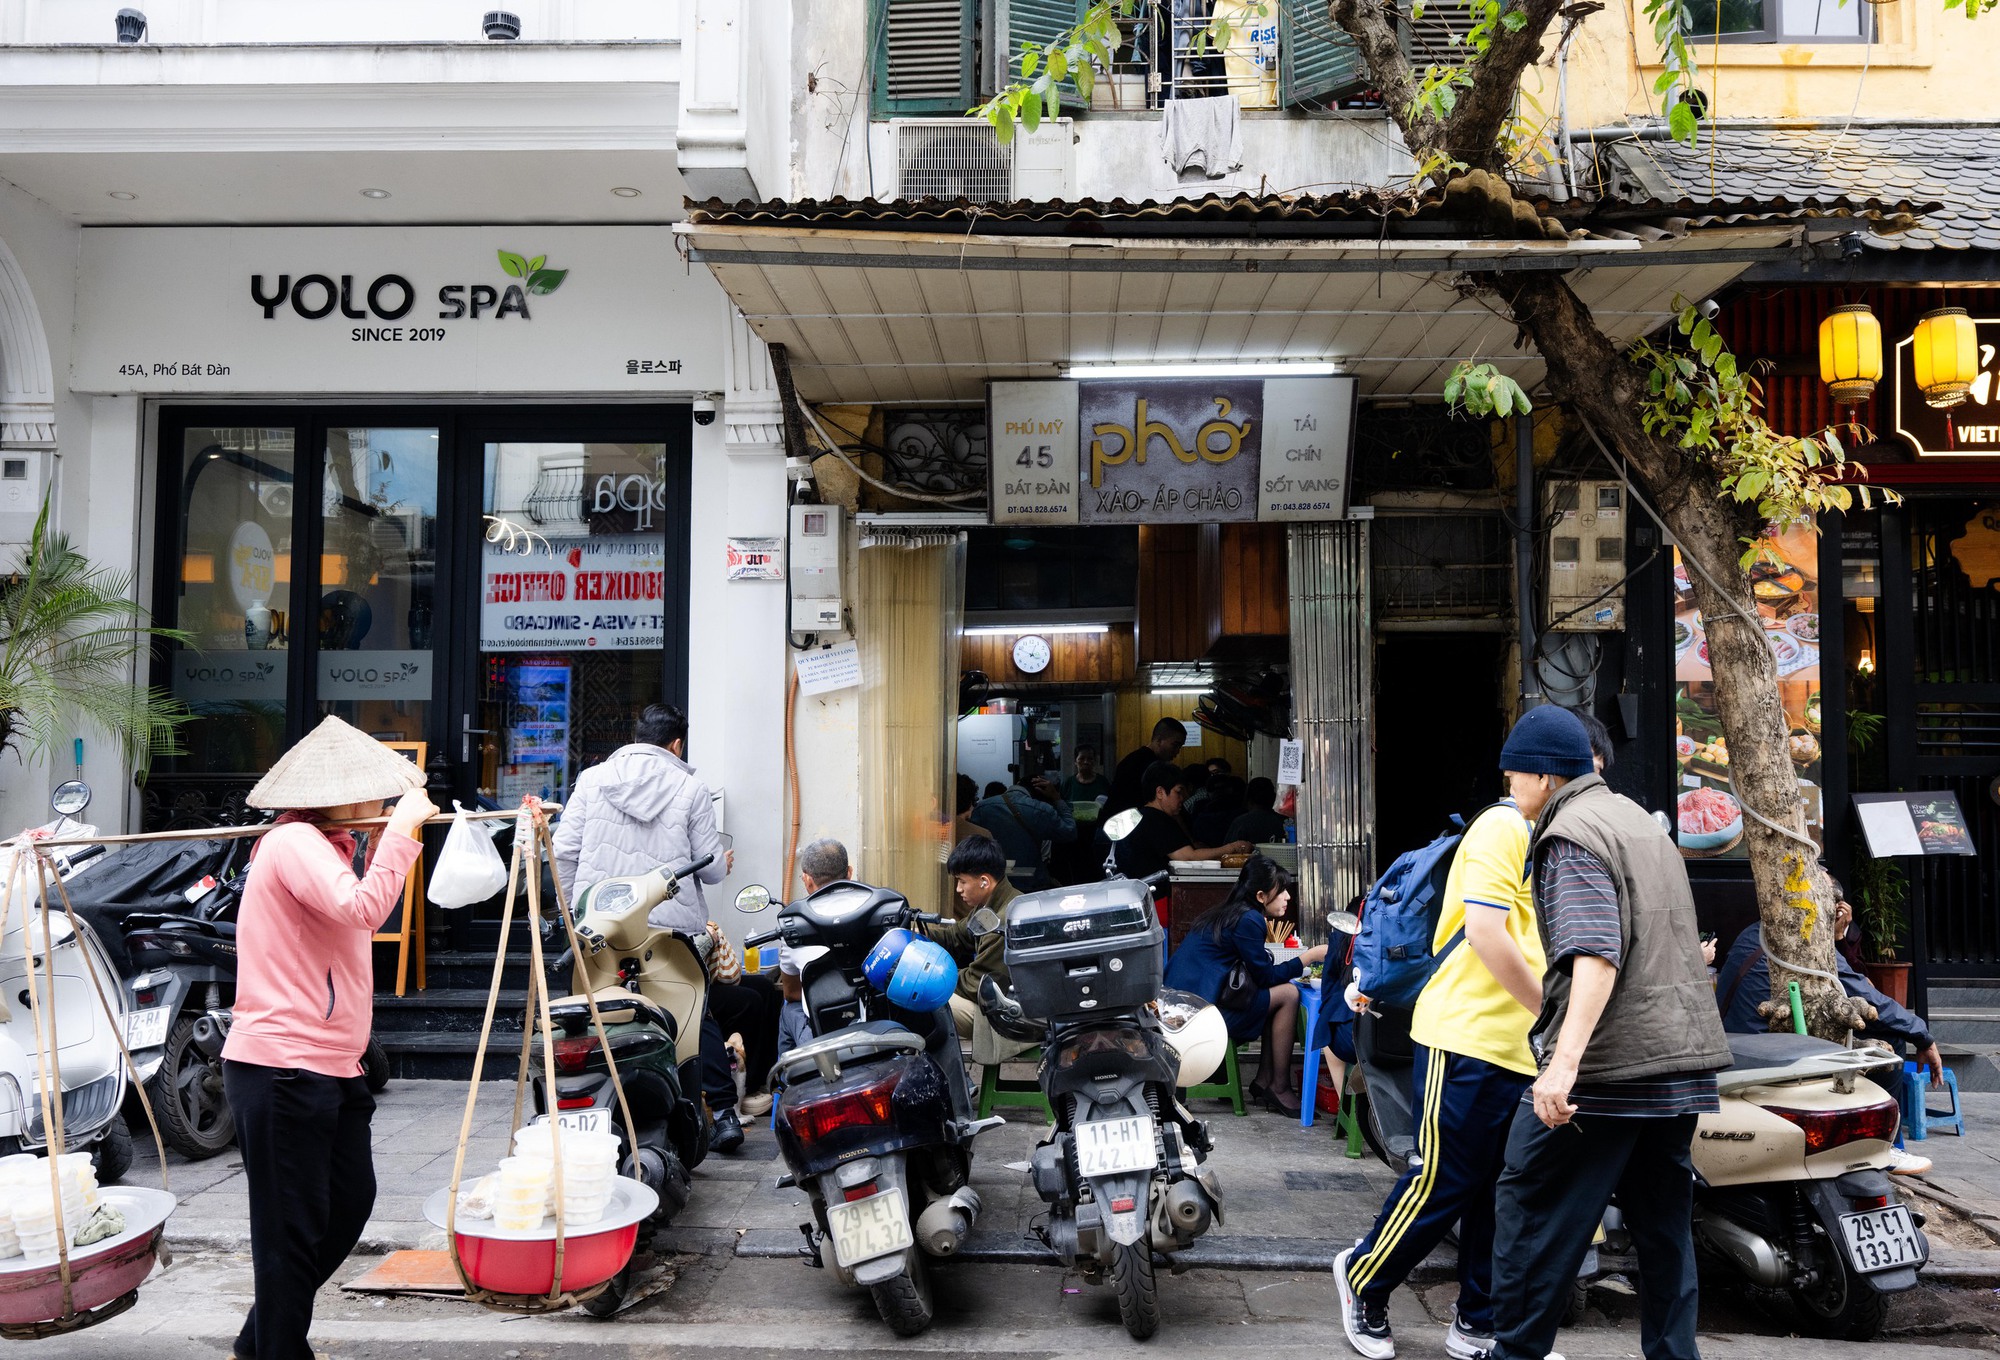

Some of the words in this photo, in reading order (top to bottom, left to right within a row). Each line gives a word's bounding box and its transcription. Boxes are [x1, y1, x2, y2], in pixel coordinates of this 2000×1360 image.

[251, 274, 415, 320] YOLO
[438, 284, 531, 320] SPA
[351, 328, 403, 342] SINCE
[409, 328, 446, 342] 2019
[119, 364, 148, 378] 45A,
[153, 362, 178, 375] Phố
[181, 363, 202, 376] Bát
[206, 363, 231, 376] Đàn
[626, 359, 682, 375] 욜로스파
[1005, 418, 1034, 435] PHÚ
[1038, 418, 1064, 435] MỸ
[1293, 416, 1317, 431] TÁI
[1090, 397, 1251, 488] phở
[1016, 446, 1054, 469] 45
[1285, 447, 1322, 461] CHÍN
[1005, 477, 1032, 495] BÁT
[1035, 478, 1070, 495] ĐÀN
[1265, 475, 1293, 493] SỐT
[1298, 479, 1340, 492] VANG
[1153, 486, 1179, 512] ÁP
[1186, 483, 1242, 512] CHẢO
[186, 668, 234, 683] YOLO
[239, 671, 265, 682] SPA
[330, 669, 378, 682] YOLO
[1063, 919, 1091, 932] GIVI
[1090, 1120, 1140, 1145] 11-H1
[838, 1147, 869, 1160] HONDA
[839, 1196, 893, 1233] 29-E1
[1851, 1210, 1905, 1242] 29-C1
